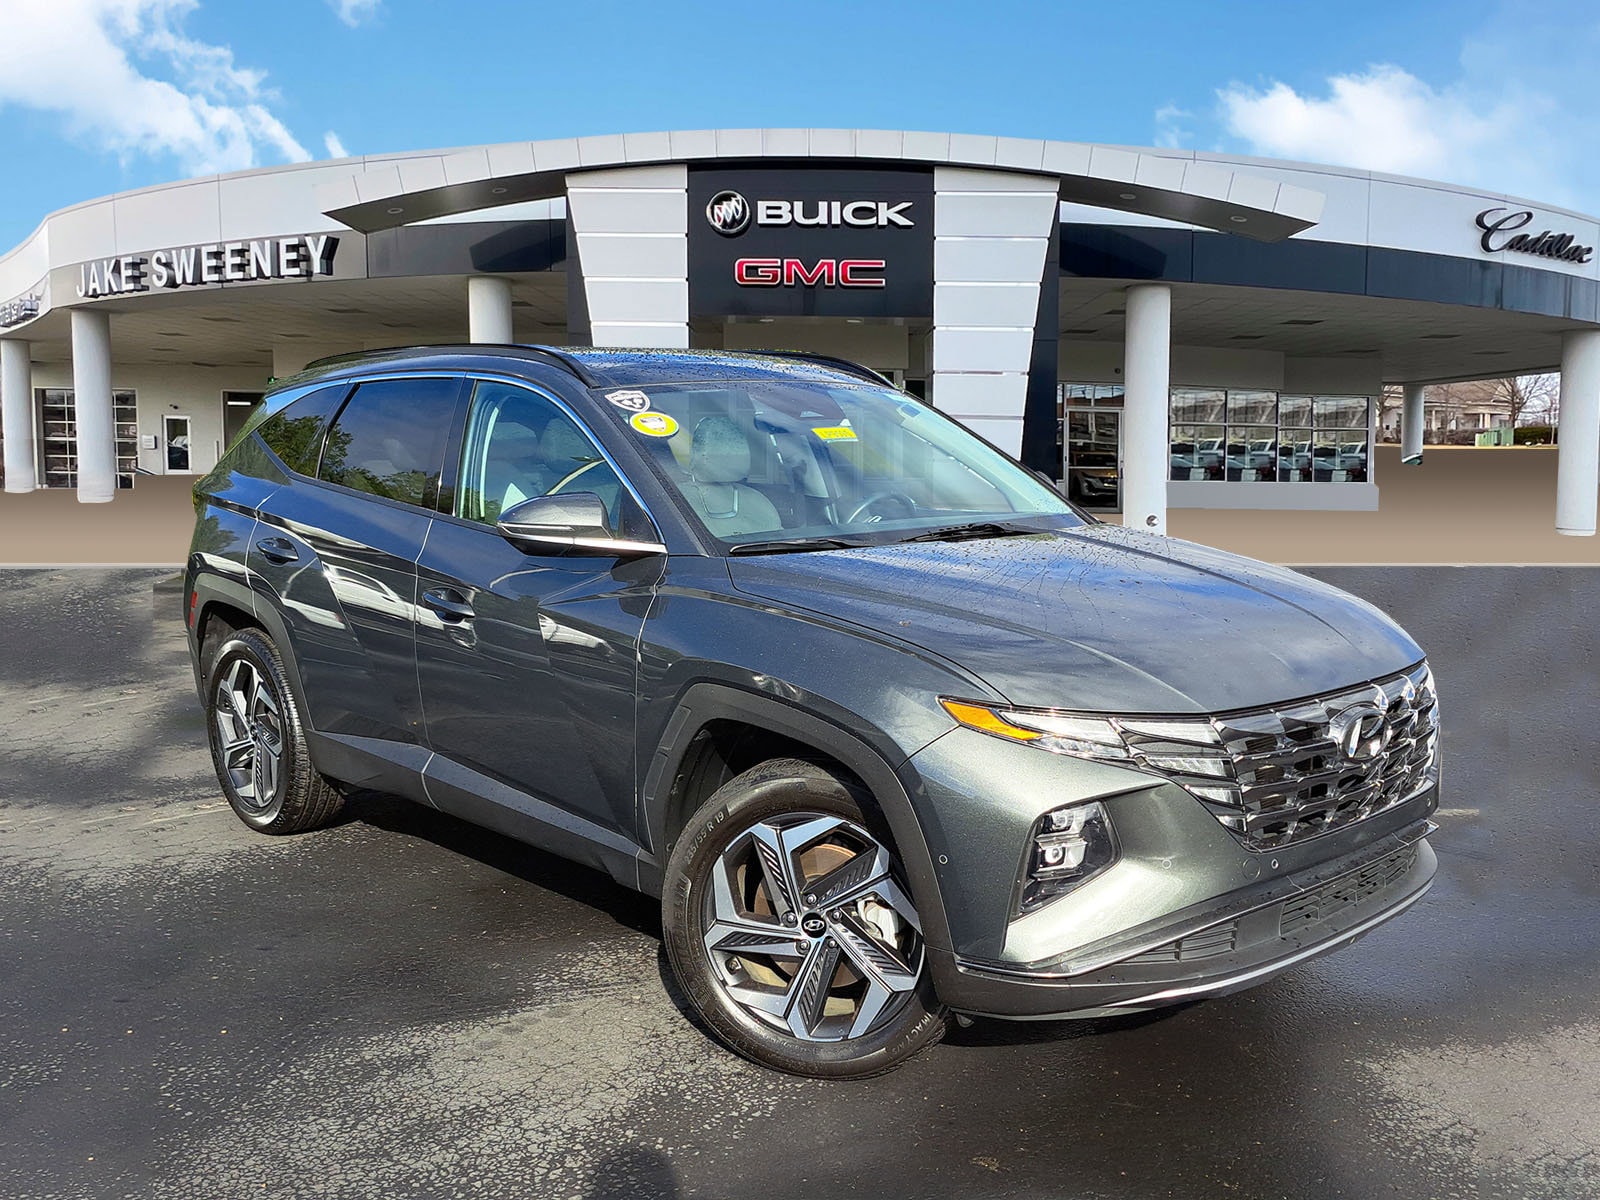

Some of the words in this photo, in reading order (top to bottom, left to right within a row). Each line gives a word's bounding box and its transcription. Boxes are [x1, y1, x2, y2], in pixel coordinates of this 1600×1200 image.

[757, 200, 915, 227] BUICK
[1475, 207, 1594, 264] Cadillac
[76, 255, 142, 298] JAKE
[152, 234, 333, 288] SWEENEY
[734, 258, 886, 287] GMC
[714, 811, 725, 824] 19
